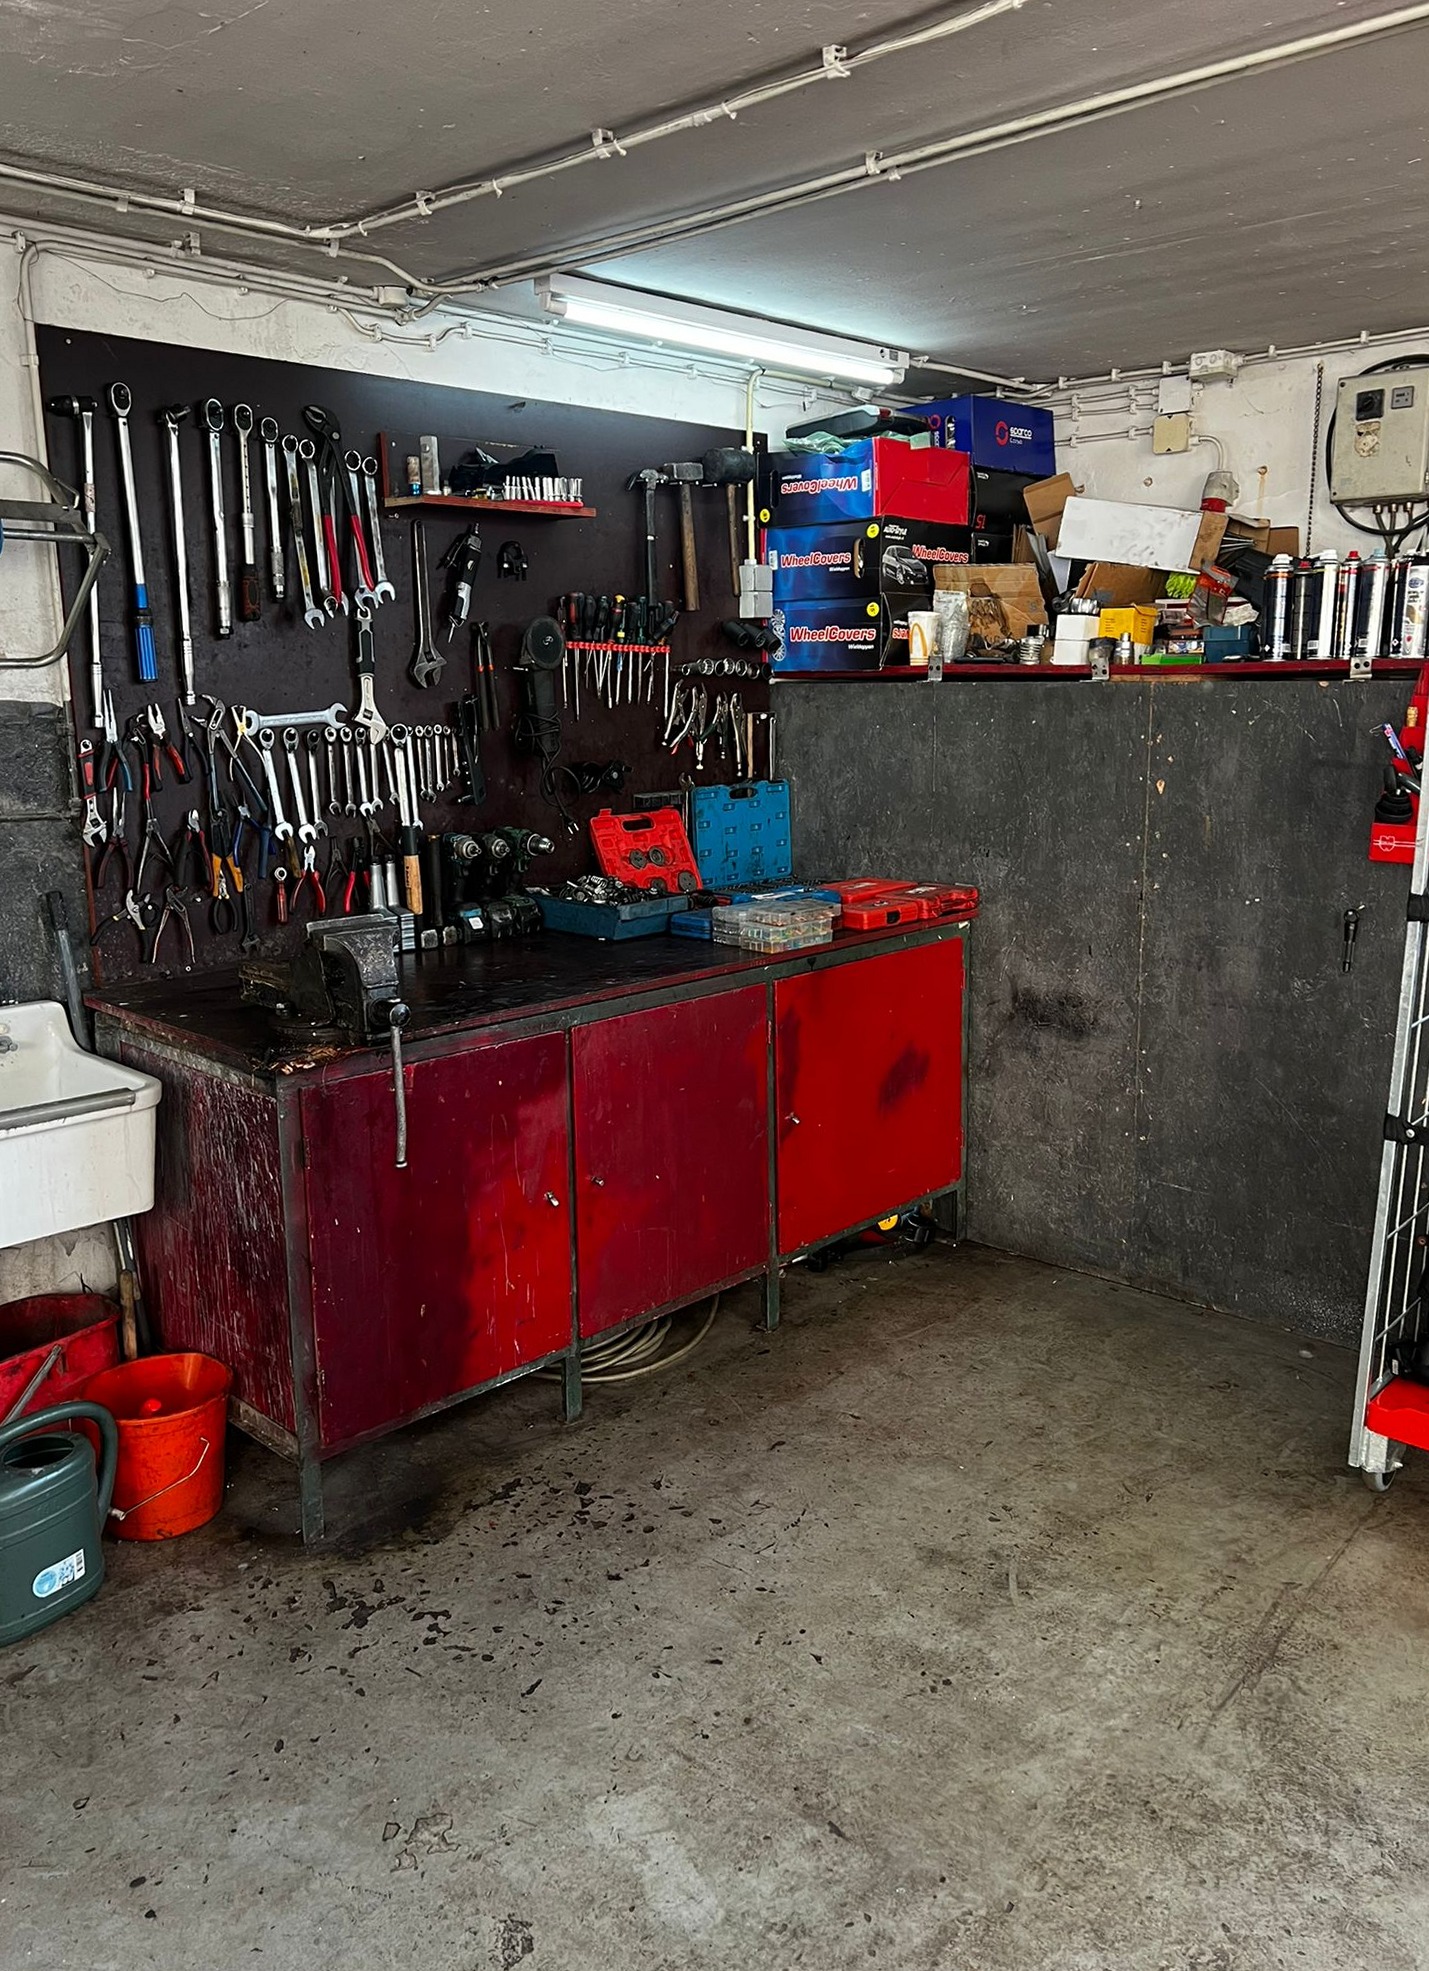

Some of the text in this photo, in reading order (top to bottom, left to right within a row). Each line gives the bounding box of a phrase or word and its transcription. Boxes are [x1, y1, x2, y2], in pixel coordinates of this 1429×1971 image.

[1009, 427, 1033, 438] sparco
[781, 477, 858, 494] WheelCovers
[781, 551, 851, 568] WheelCovers
[911, 544, 969, 563] WheelCovers
[789, 625, 876, 642] WheelCovers
